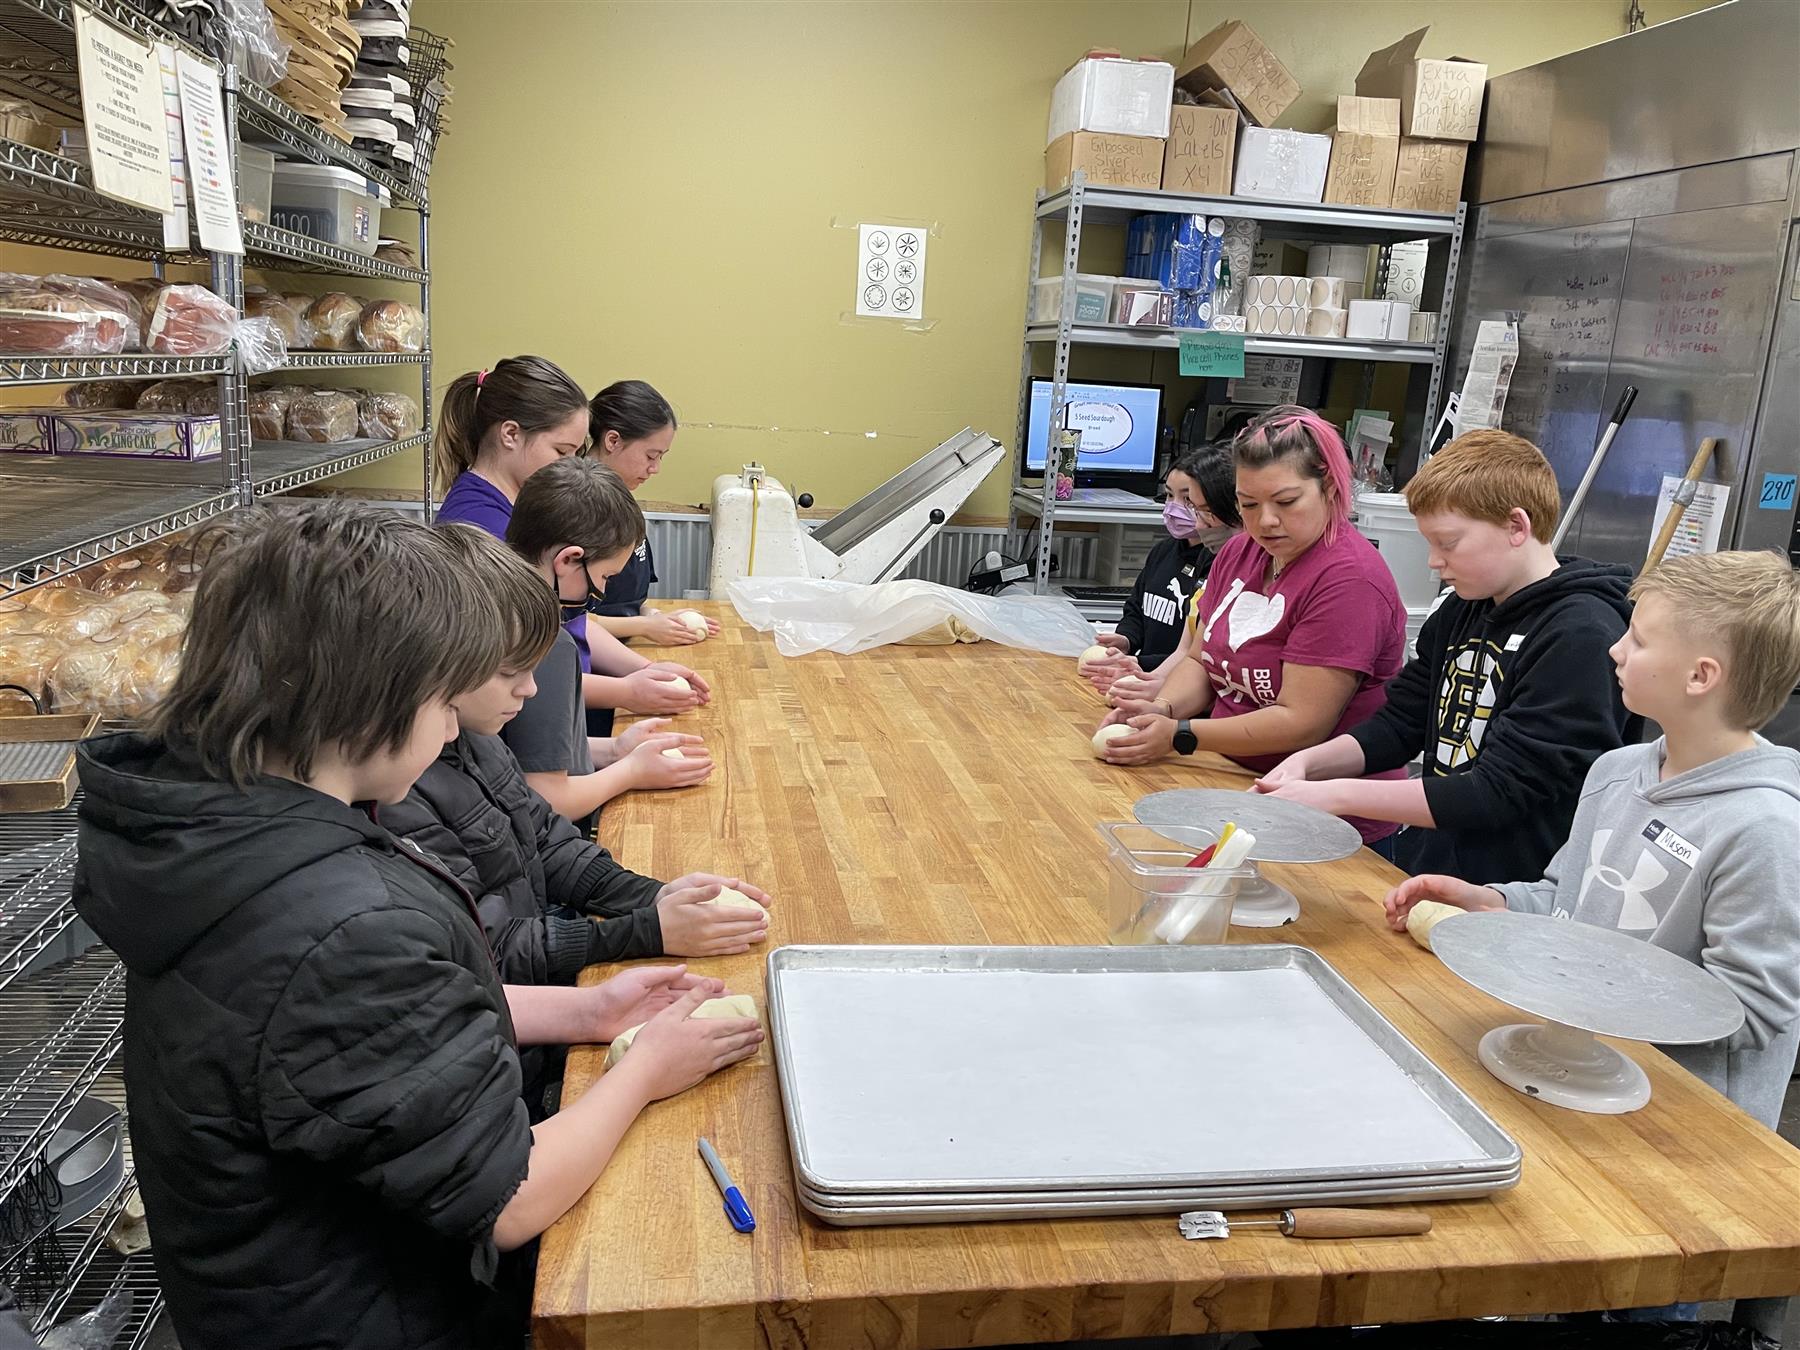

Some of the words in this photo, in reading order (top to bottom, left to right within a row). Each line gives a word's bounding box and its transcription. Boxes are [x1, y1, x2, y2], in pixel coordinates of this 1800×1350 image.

[1423, 63, 1469, 83] Extra
[1091, 414, 1115, 422] Sourdough
[111, 432, 132, 448] KING
[134, 433, 156, 449] CAKE
[1660, 831, 1692, 860] Mason
